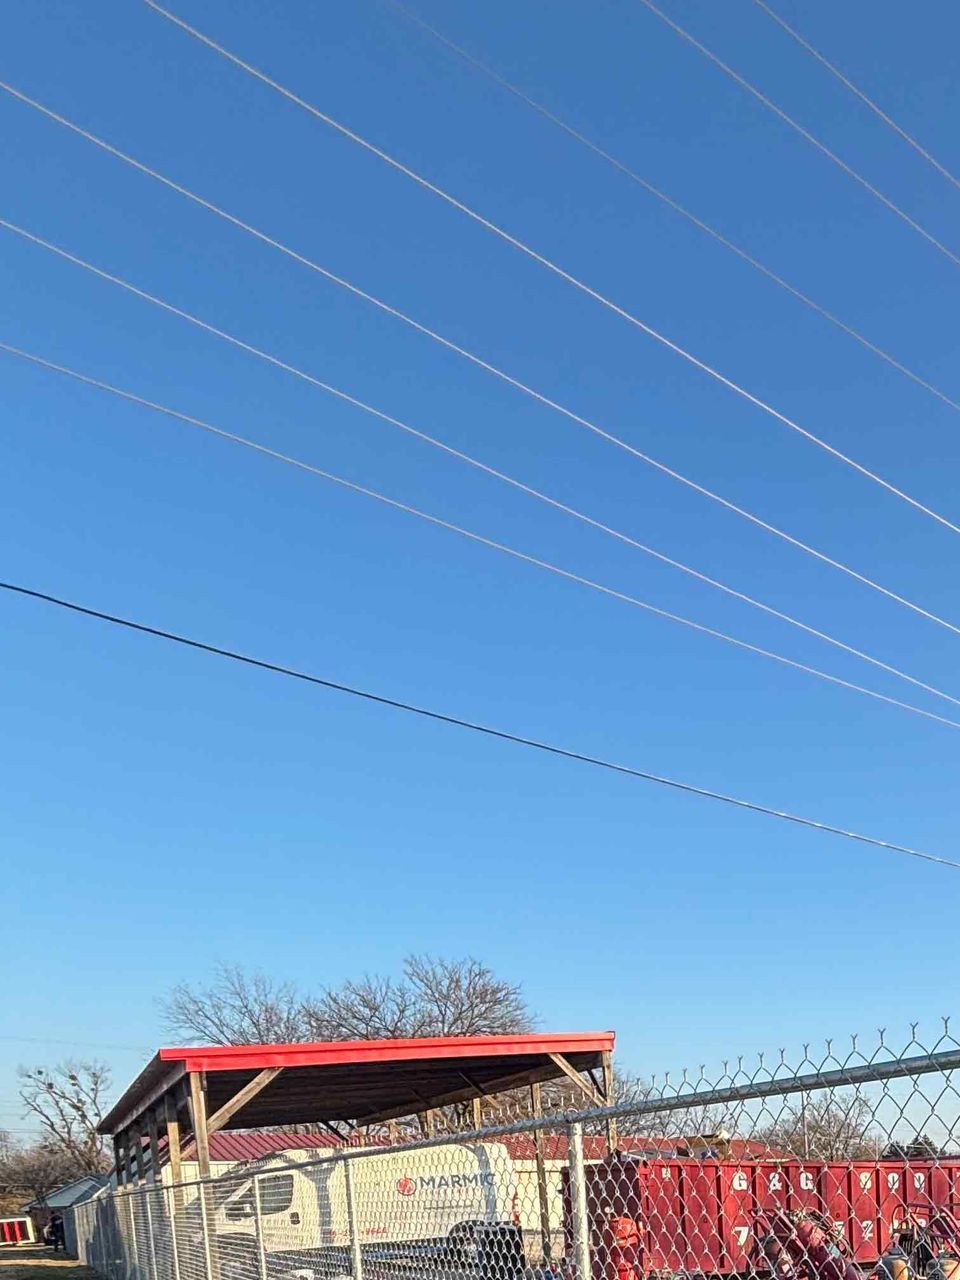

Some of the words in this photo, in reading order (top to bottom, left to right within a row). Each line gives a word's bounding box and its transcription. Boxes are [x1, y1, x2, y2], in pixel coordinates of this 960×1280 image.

[419, 1173, 497, 1188] MARMIC
[732, 1172, 748, 1190] G
[768, 1172, 783, 1190] &
[800, 1172, 813, 1190] G
